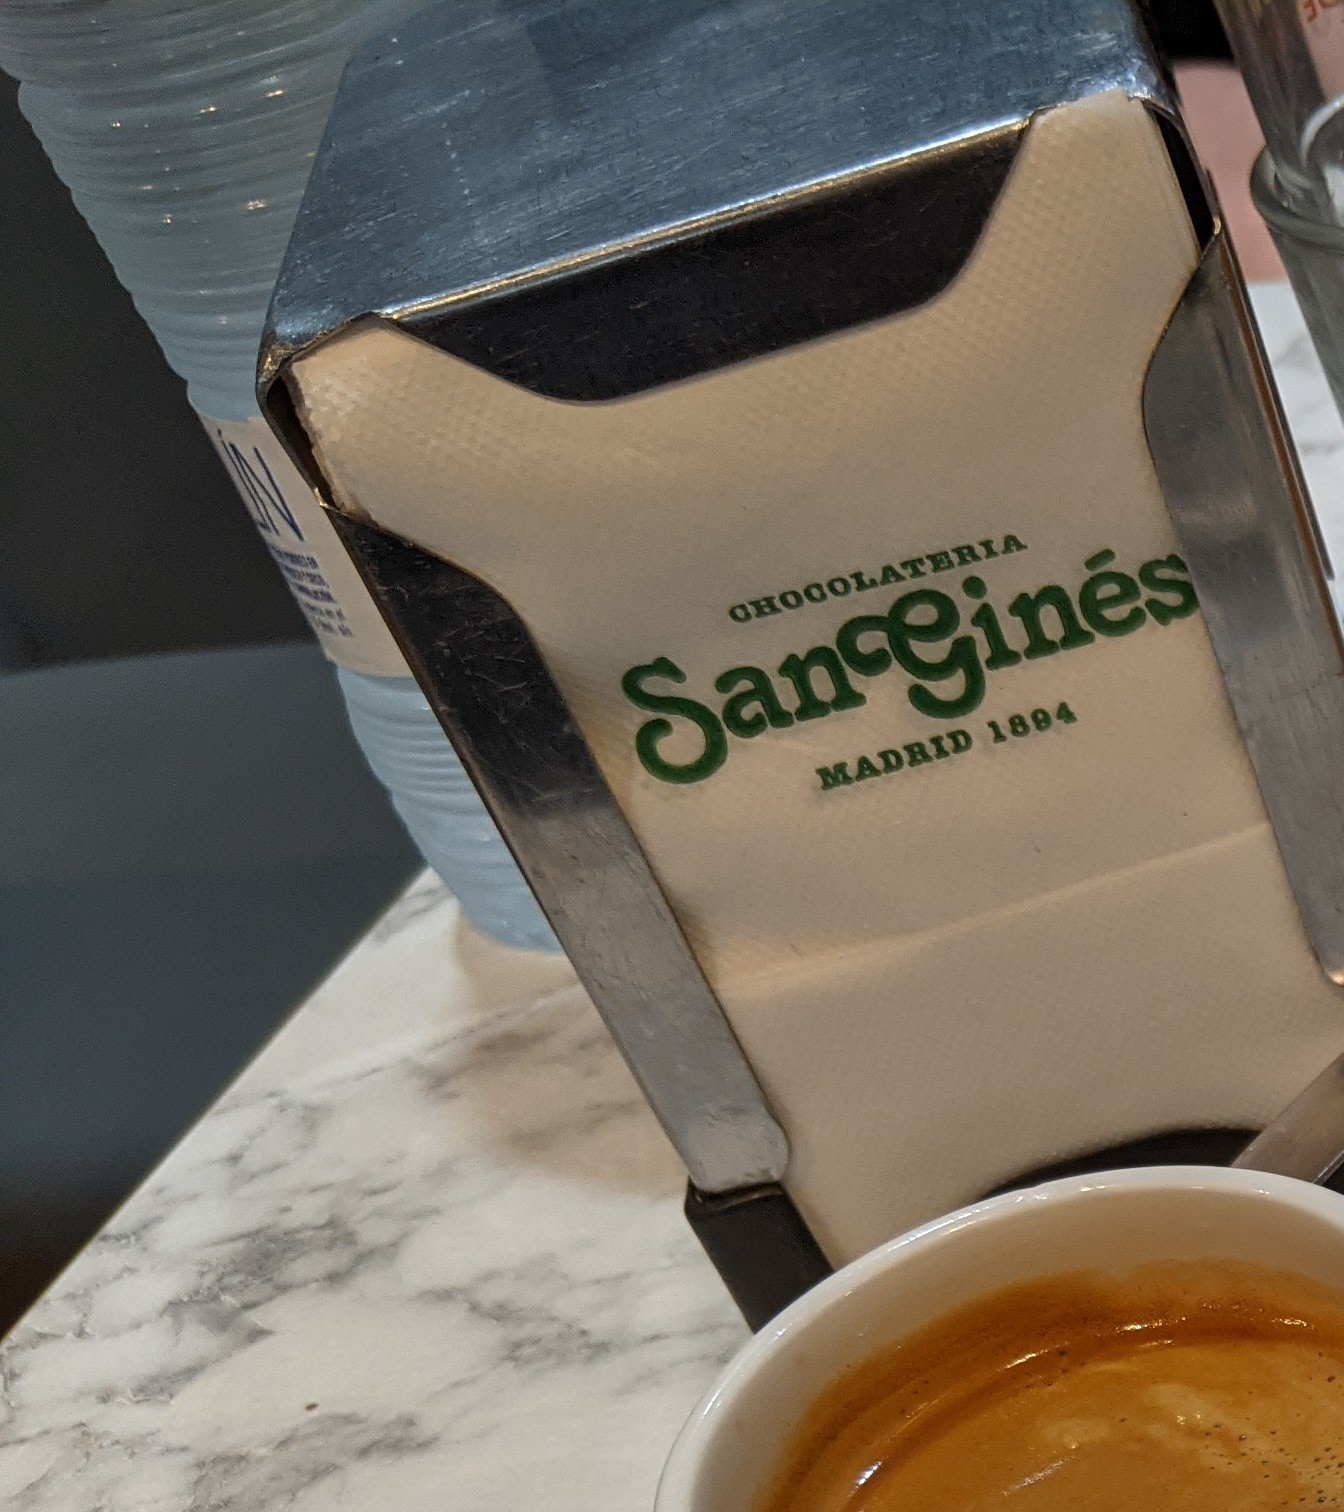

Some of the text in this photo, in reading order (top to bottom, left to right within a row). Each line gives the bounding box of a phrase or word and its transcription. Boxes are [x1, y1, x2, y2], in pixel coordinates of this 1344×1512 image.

[728, 534, 1028, 624] CHOCOLATERIA
[814, 701, 1078, 791] MADRID 1894
